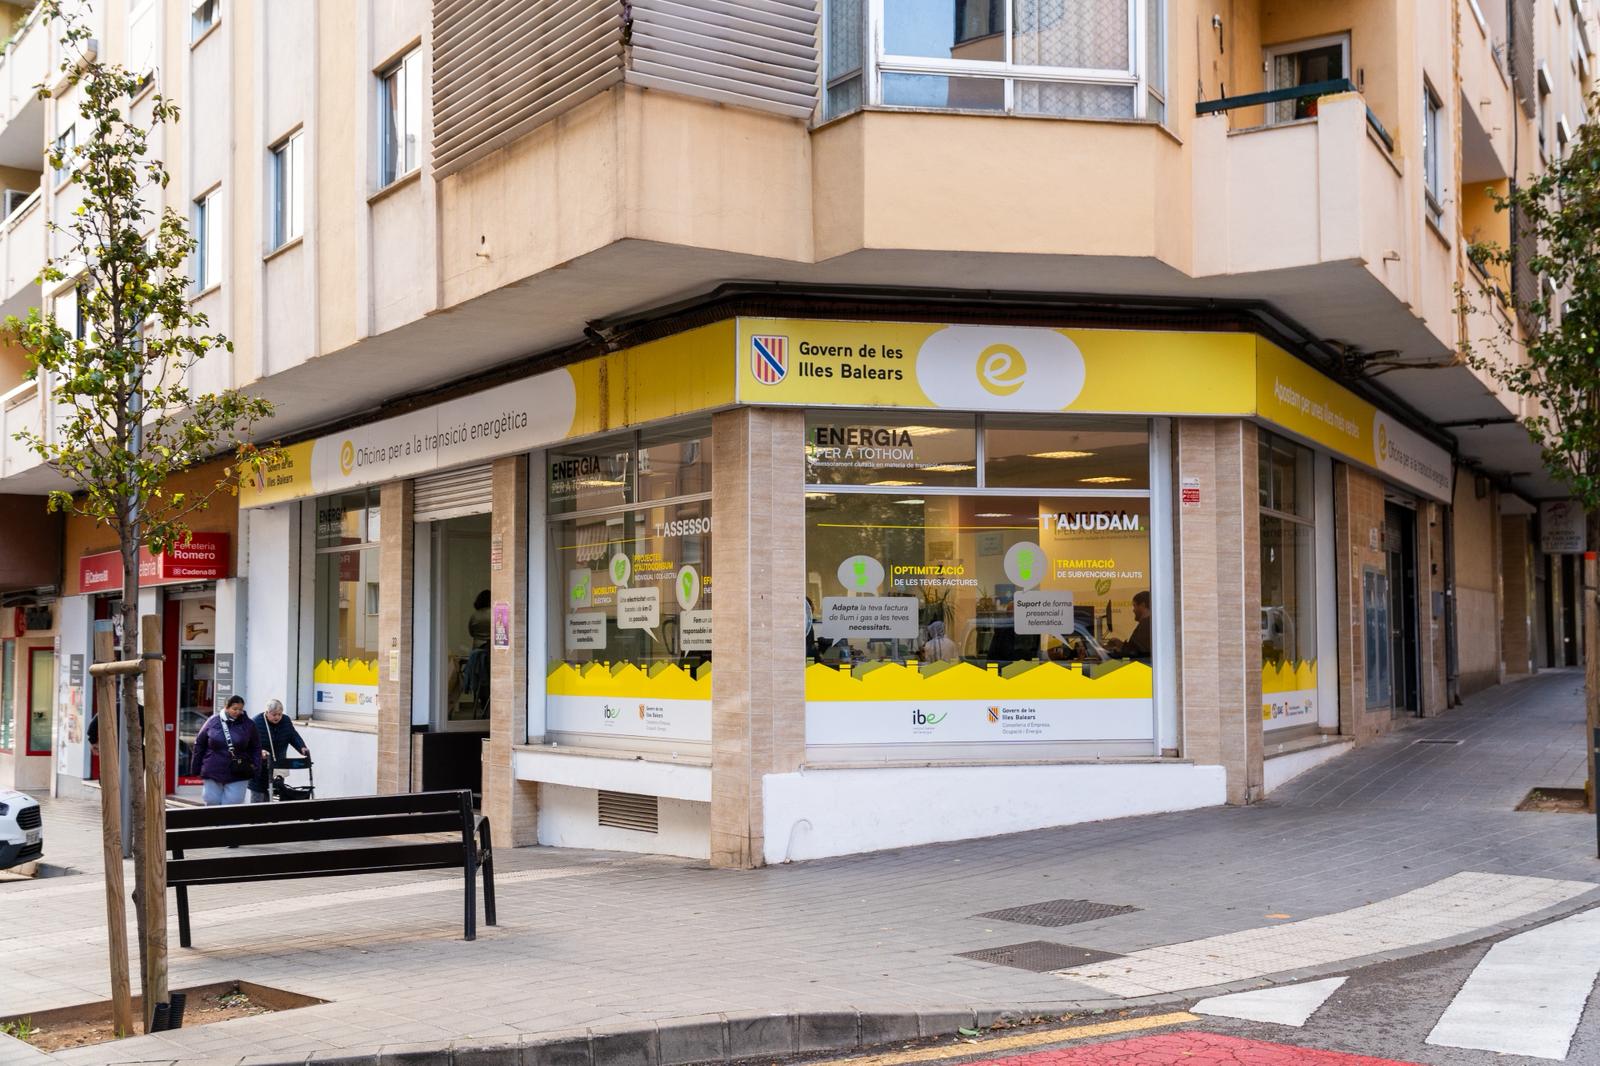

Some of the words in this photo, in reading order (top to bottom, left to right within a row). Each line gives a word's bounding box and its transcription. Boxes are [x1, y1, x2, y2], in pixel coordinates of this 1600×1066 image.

[799, 342, 853, 357] Govern
[858, 344, 876, 358] de
[882, 345, 904, 359] les
[798, 362, 833, 378] Illes
[840, 363, 904, 381] Balears
[356, 446, 386, 467] Oficina
[388, 442, 402, 464] per
[405, 440, 410, 456] a
[413, 434, 422, 454] la
[424, 422, 468, 450] transició
[470, 411, 528, 440] energètica
[816, 427, 913, 447] ENERGIA
[816, 448, 842, 460] PER
[844, 448, 854, 459] A
[552, 456, 600, 480] ENERGIA
[655, 516, 712, 538] T'ASSESSO
[174, 550, 216, 560] Romero
[1056, 558, 1115, 568] TRAMITACIÓ
[894, 564, 964, 576] OPTIMITZACIÓ
[1068, 570, 1116, 578] SUBVENCIONS
[832, 604, 858, 612] Adapta
[860, 604, 868, 612] la
[884, 604, 908, 612] factura
[1016, 600, 1042, 609] Suport
[1052, 600, 1072, 608] forma
[829, 614, 838, 622] de
[839, 614, 854, 622] llum
[860, 615, 872, 623] gas
[1026, 610, 1060, 618] presencial
[848, 623, 892, 631] necessitats.
